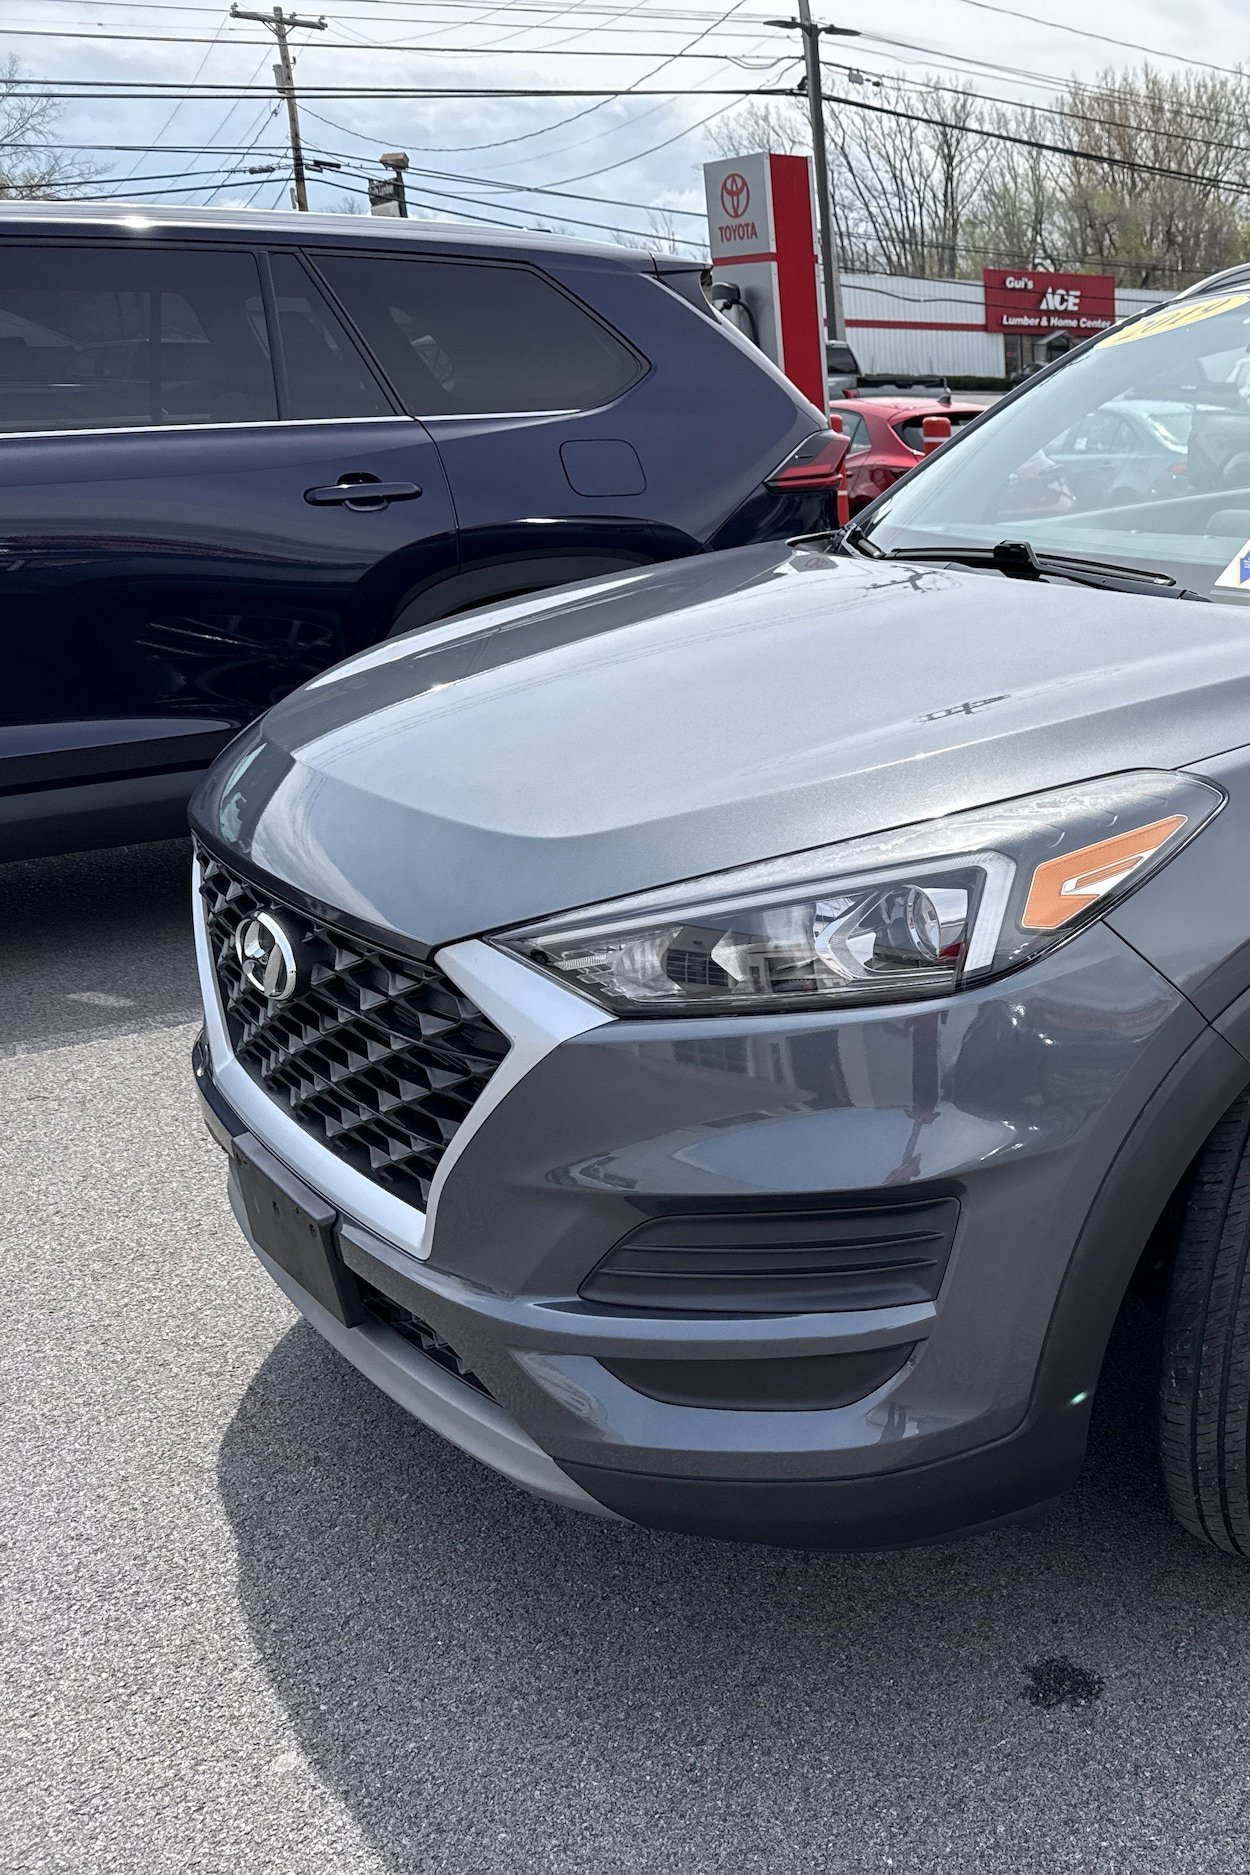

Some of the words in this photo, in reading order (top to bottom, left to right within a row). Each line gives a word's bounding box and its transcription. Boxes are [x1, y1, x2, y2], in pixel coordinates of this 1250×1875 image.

[718, 221, 758, 243] TOYOTA
[1006, 277, 1034, 289] Gui's
[1040, 287, 1081, 311] ACE
[1002, 315, 1040, 327] Lumber
[1040, 317, 1049, 328] &
[1050, 317, 1078, 329] Home
[1079, 318, 1111, 330] Center
